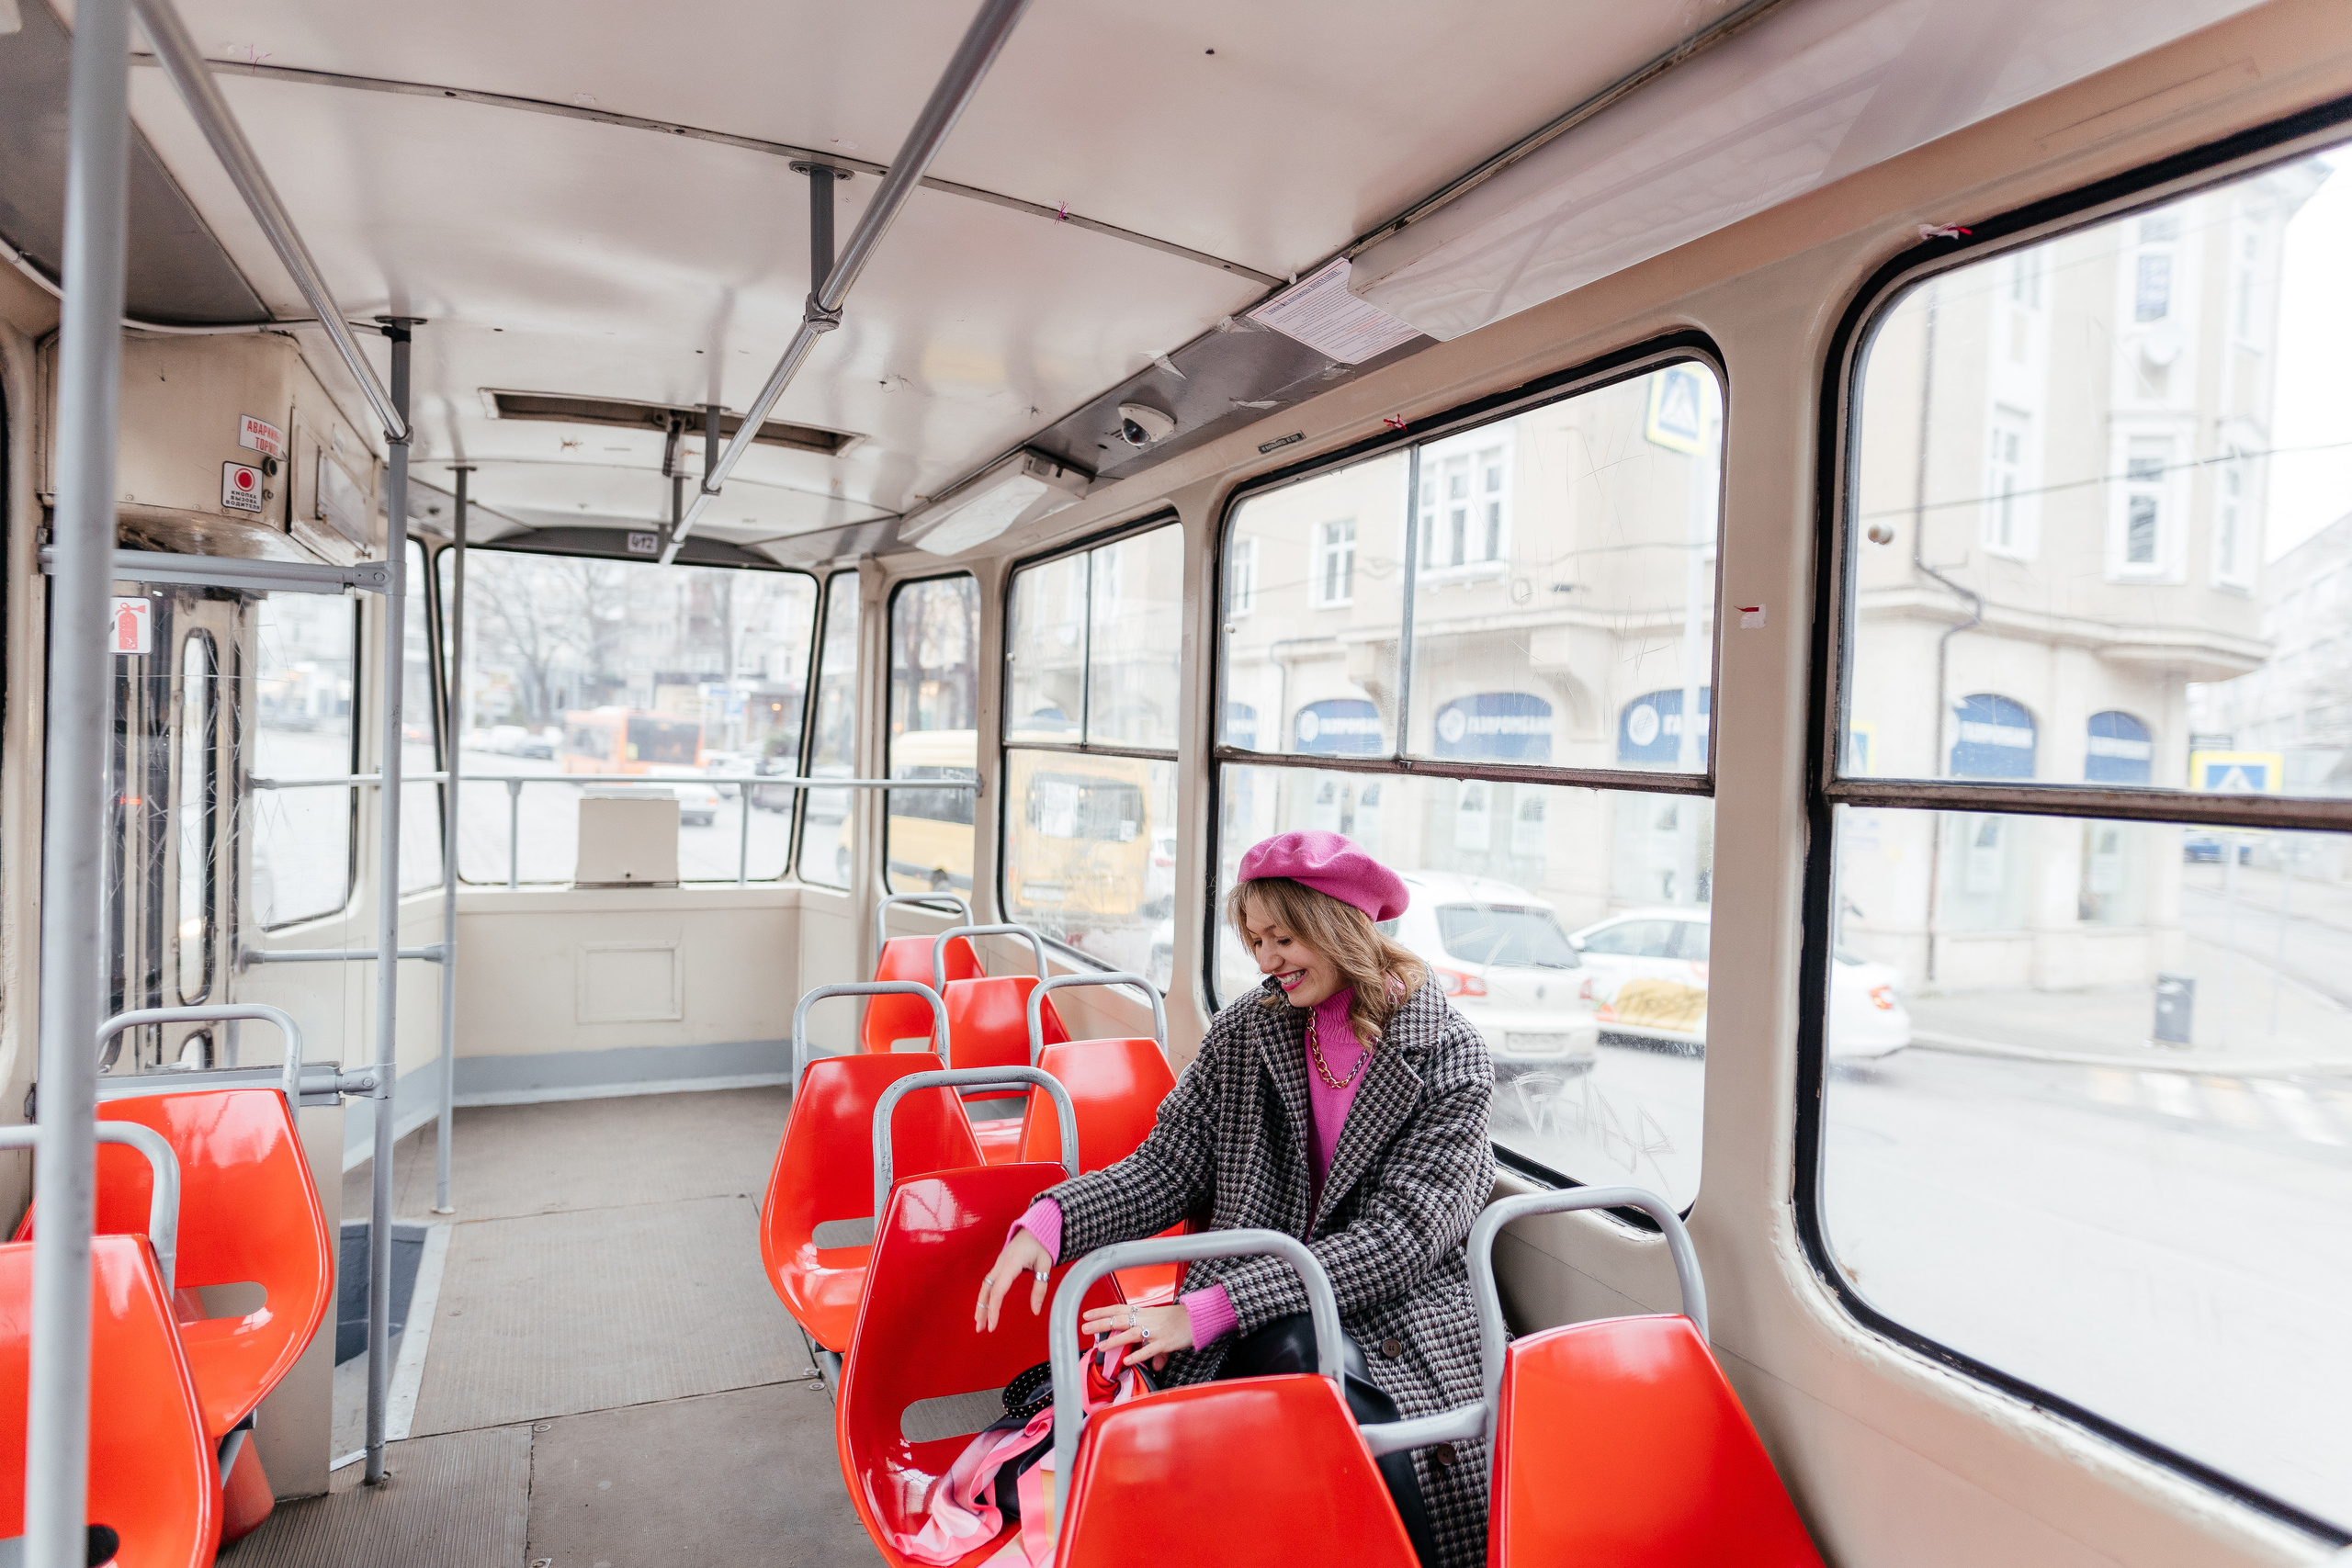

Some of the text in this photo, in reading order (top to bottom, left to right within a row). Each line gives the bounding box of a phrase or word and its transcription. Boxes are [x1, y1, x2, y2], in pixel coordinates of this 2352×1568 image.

[231, 495, 256, 504] ВЫЗОВА
[232, 491, 256, 499] КНОПКА
[226, 500, 260, 510] ВОДИТЕЛЯ
[632, 536, 654, 549] 412
